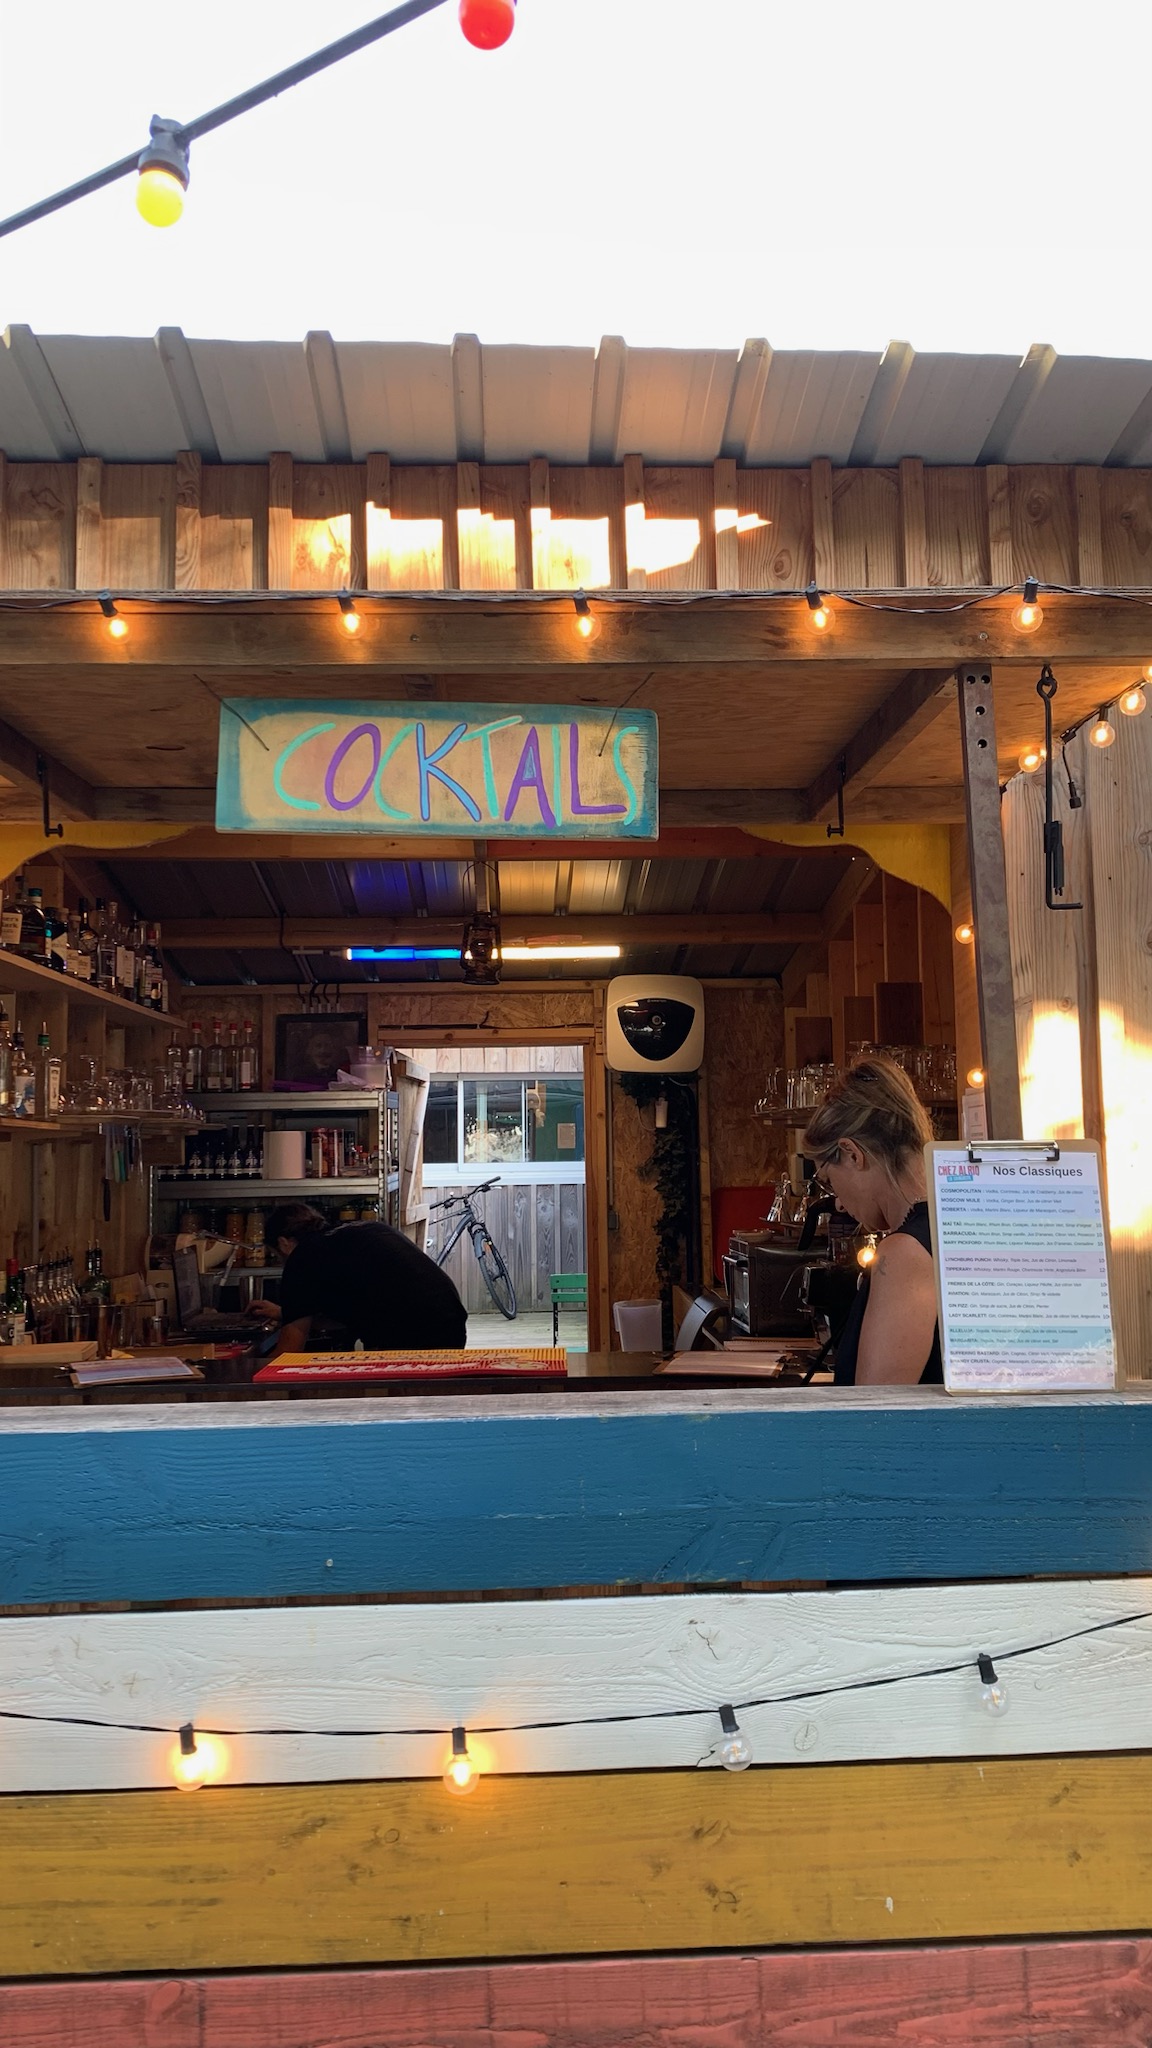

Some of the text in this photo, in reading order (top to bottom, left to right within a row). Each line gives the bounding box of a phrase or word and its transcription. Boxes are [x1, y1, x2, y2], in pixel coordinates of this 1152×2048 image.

[273, 715, 639, 829] COCKTAILS
[938, 1165, 957, 1176] CHEZ
[993, 1166, 1016, 1176] Nos
[1019, 1166, 1083, 1178] Classiques
